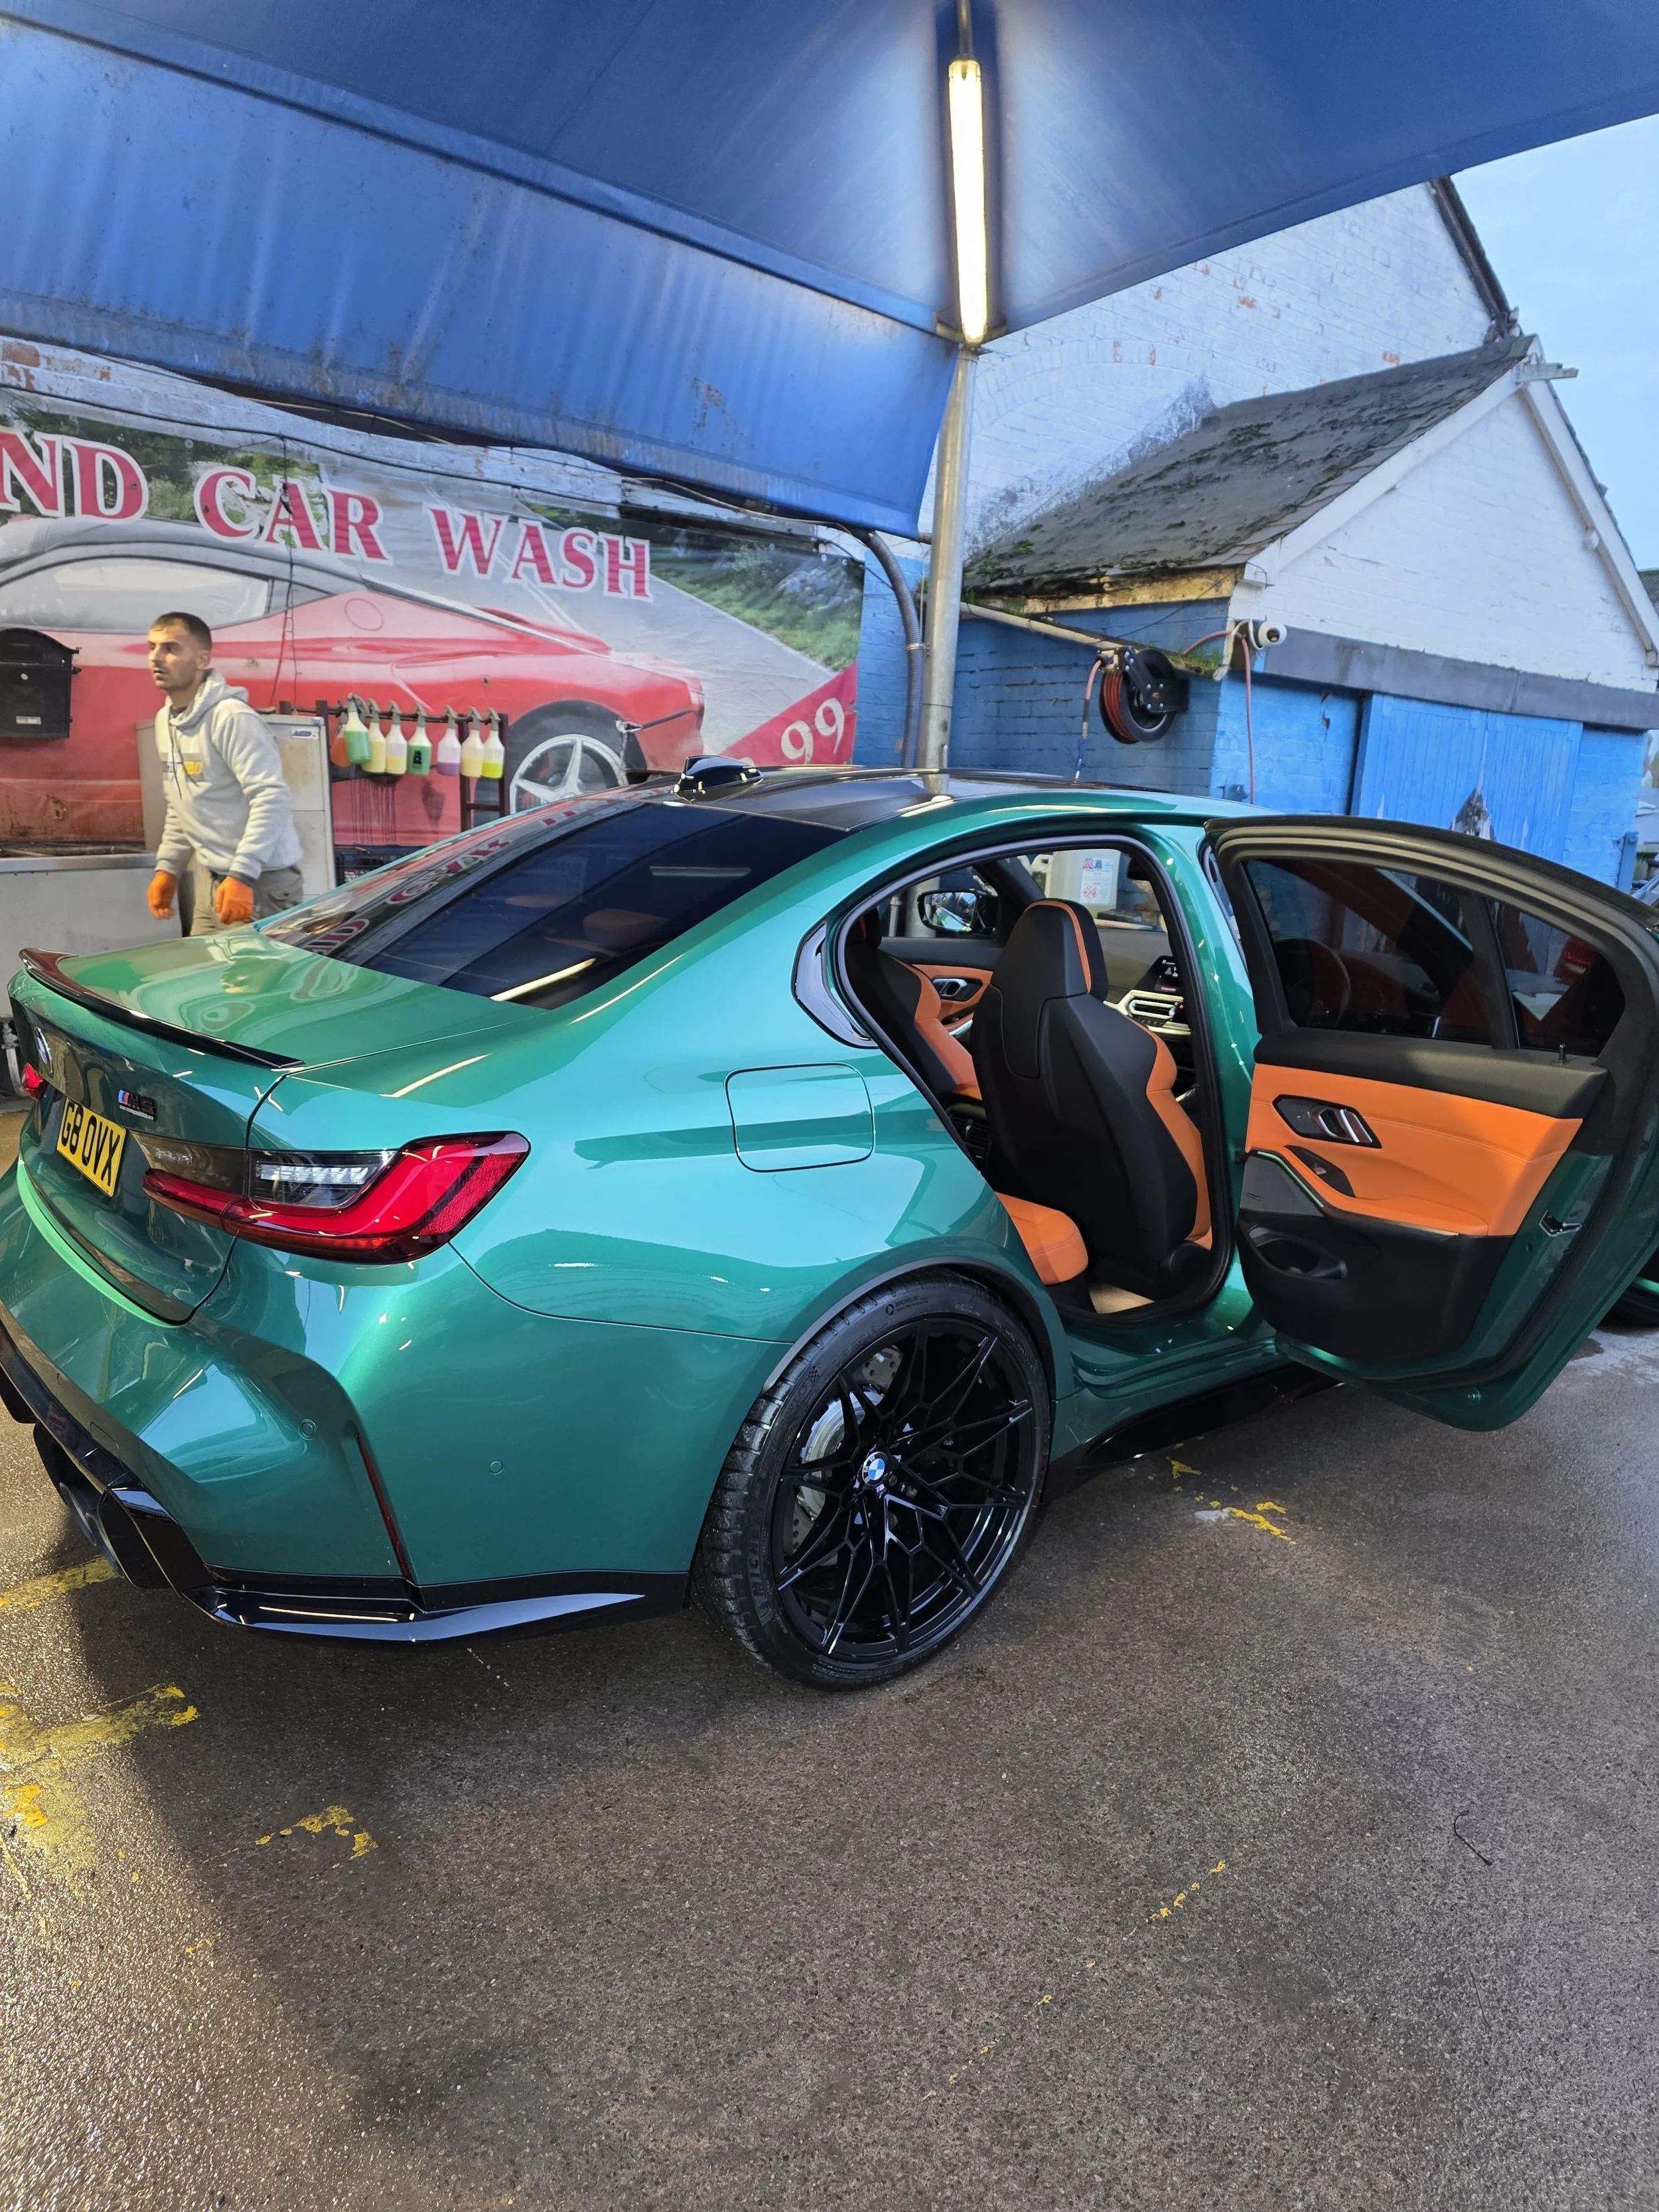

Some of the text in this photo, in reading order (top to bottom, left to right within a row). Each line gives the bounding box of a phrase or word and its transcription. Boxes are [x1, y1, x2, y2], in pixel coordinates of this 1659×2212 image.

[195, 467, 392, 563] CAR
[424, 503, 652, 601] WASH
[62, 1102, 120, 1187] G8 OVX
